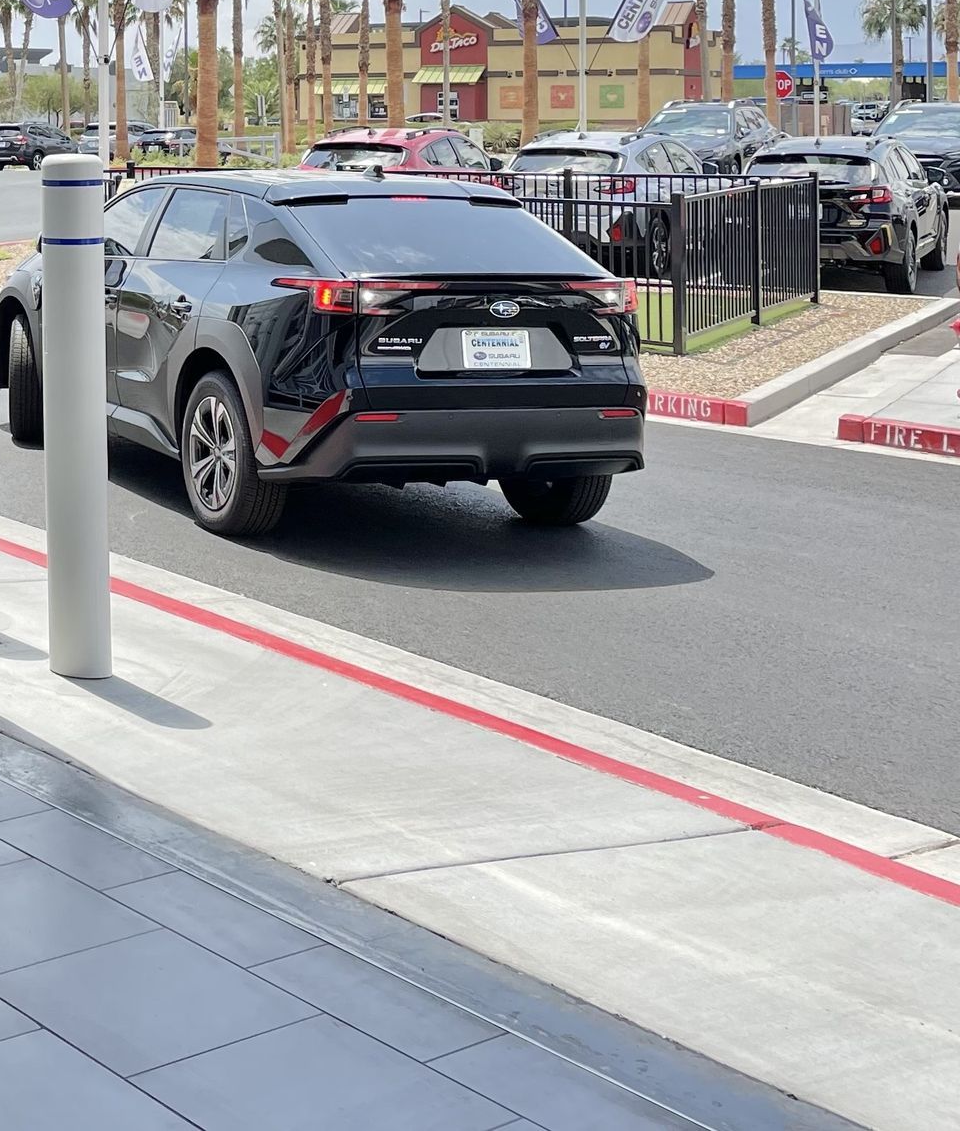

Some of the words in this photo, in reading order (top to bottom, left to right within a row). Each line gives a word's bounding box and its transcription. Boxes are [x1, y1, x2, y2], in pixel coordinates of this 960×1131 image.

[450, 36, 477, 49] TACO
[775, 79, 791, 90] OP
[471, 338, 519, 347] CENTENNIAL
[647, 394, 711, 417] RKING
[870, 422, 923, 449] FIRE
